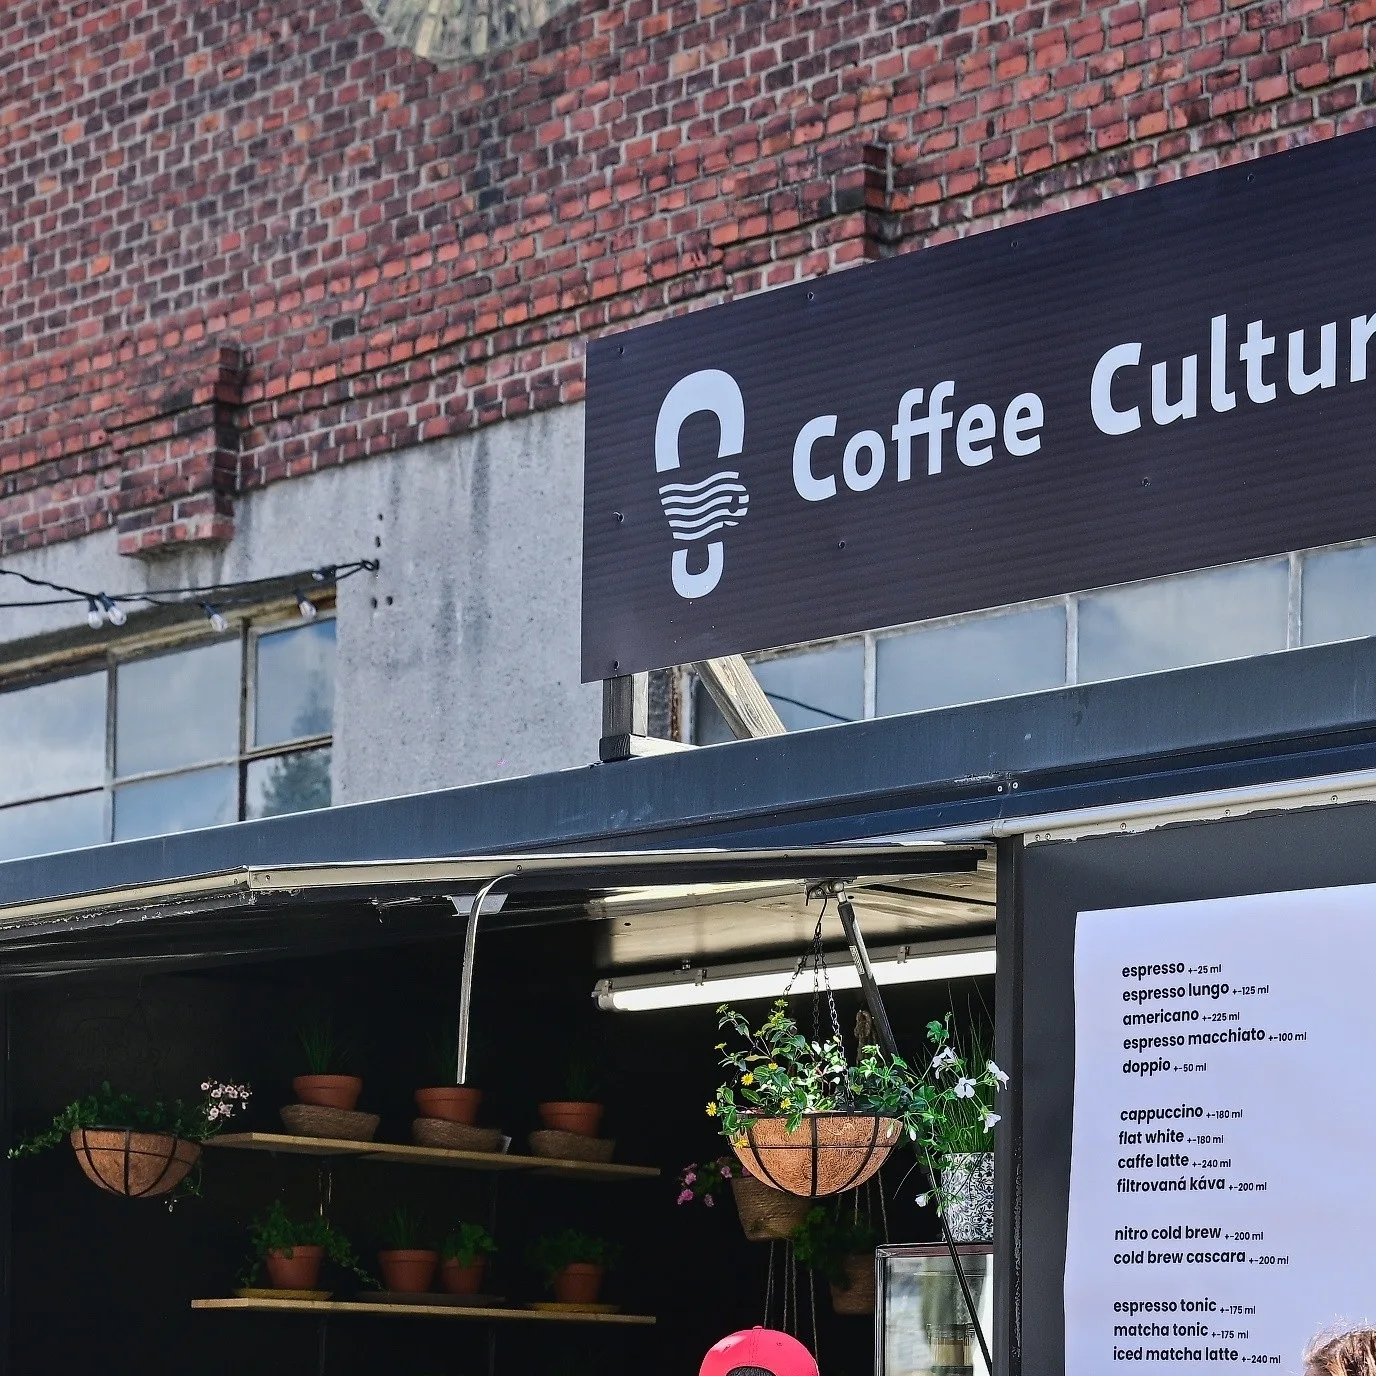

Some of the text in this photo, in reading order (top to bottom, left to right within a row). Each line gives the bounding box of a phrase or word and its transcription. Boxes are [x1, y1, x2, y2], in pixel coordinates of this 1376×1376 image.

[793, 380, 1044, 502] Coffee
[1122, 963, 1185, 981] espresso
[1210, 964, 1221, 973] ml
[1123, 987, 1185, 1005] espresso
[1189, 983, 1229, 999] lungo
[1257, 985, 1269, 994] ml
[1123, 1008, 1199, 1026] americano
[1229, 1011, 1240, 1021] ml
[1123, 1035, 1185, 1053] espresso
[1188, 1027, 1265, 1045] macchiato
[1295, 1031, 1307, 1041] ml
[1123, 1057, 1170, 1077] doppio
[1195, 1062, 1206, 1072] ml
[1120, 1103, 1203, 1125] cappuccino
[1231, 1109, 1243, 1118] ml
[1119, 1131, 1142, 1145] flat
[1145, 1128, 1184, 1144] white
[1212, 1135, 1224, 1143] ml
[1118, 1153, 1153, 1169] caffe
[1157, 1154, 1189, 1167] latte
[1220, 1159, 1231, 1168] ml
[1117, 1175, 1186, 1193] filtrovaná
[1190, 1175, 1225, 1190] káva
[1256, 1182, 1267, 1191] ml
[1115, 1226, 1148, 1240] nitro
[1151, 1225, 1181, 1239] cold
[1185, 1225, 1221, 1239] brew
[1252, 1231, 1263, 1240] ml
[1114, 1250, 1144, 1264] cold
[1148, 1250, 1183, 1264] brew
[1186, 1252, 1245, 1263] cascara
[1277, 1256, 1289, 1264] ml
[1114, 1301, 1177, 1317] espresso
[1180, 1297, 1217, 1312] tonic
[1244, 1305, 1256, 1314] ml
[1114, 1323, 1169, 1336] matcha
[1173, 1321, 1208, 1336] tonic
[1237, 1330, 1249, 1339] ml
[1113, 1346, 1143, 1360] iced
[1146, 1347, 1202, 1361] matcha
[1205, 1347, 1238, 1361] latte
[1269, 1355, 1281, 1364] ml
